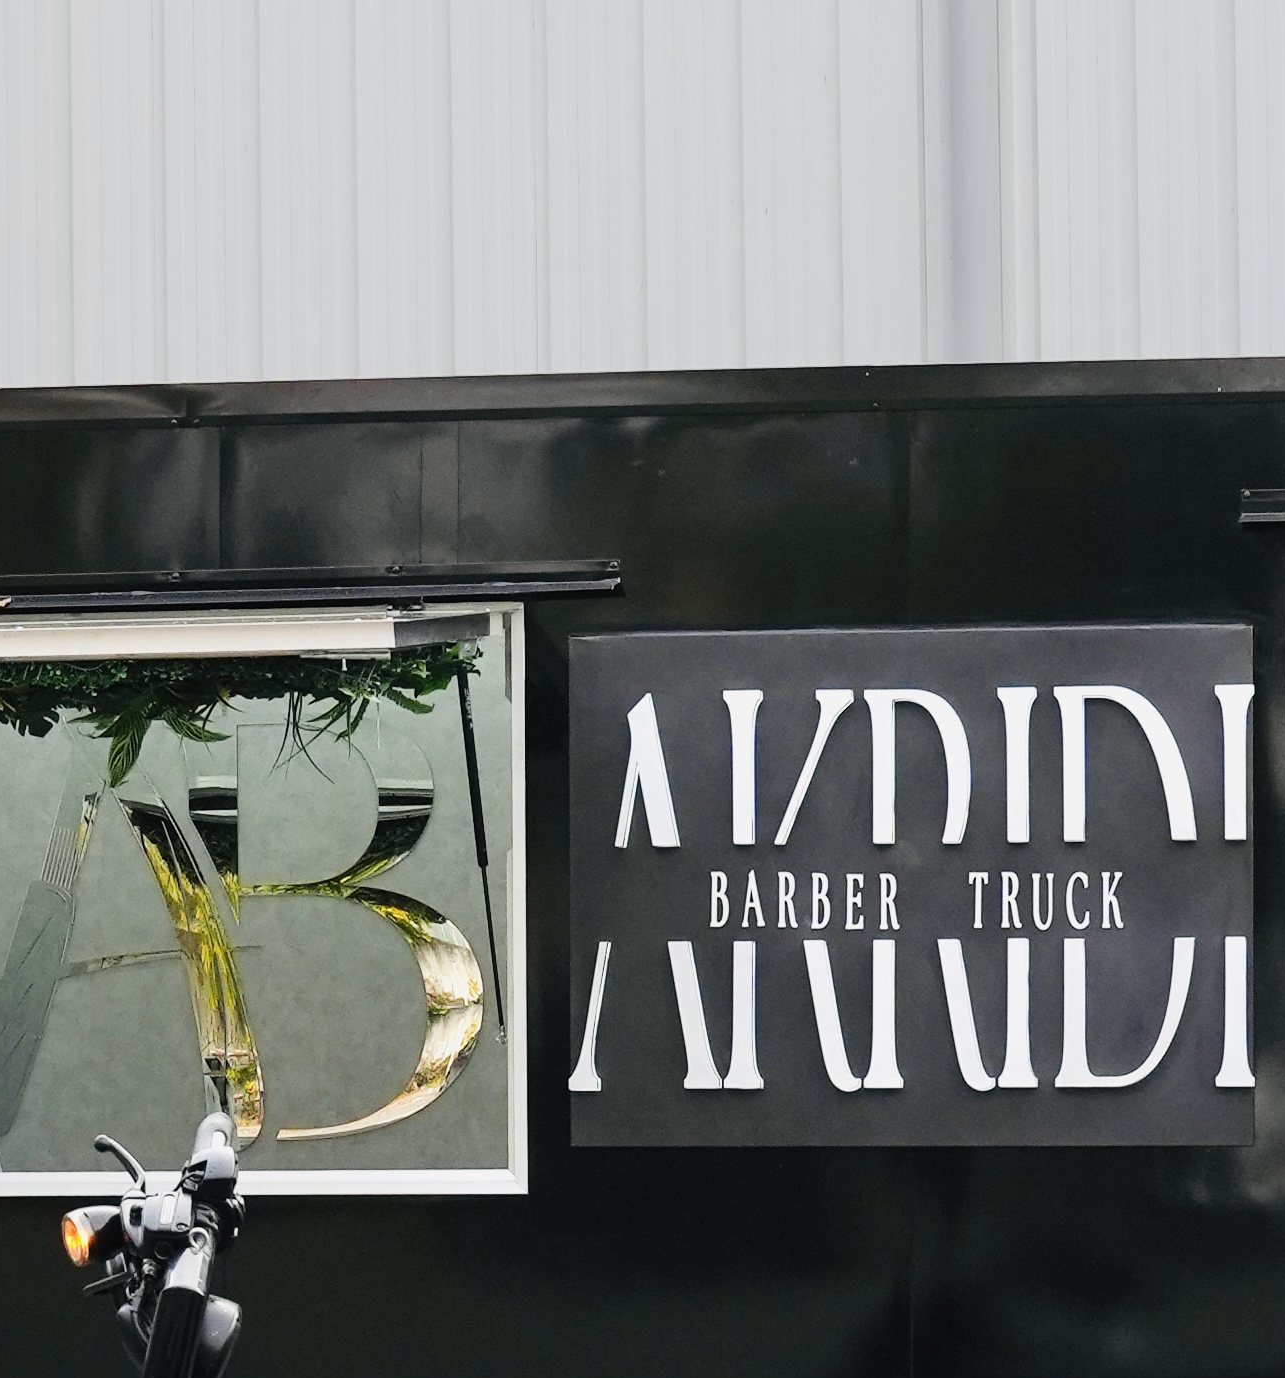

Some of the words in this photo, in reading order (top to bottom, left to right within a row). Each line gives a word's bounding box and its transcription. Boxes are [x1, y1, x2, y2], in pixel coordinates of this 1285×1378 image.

[569, 684, 1255, 1091] AKRIDI
[710, 870, 901, 931] BARBER
[968, 871, 1125, 931] TRUCK
